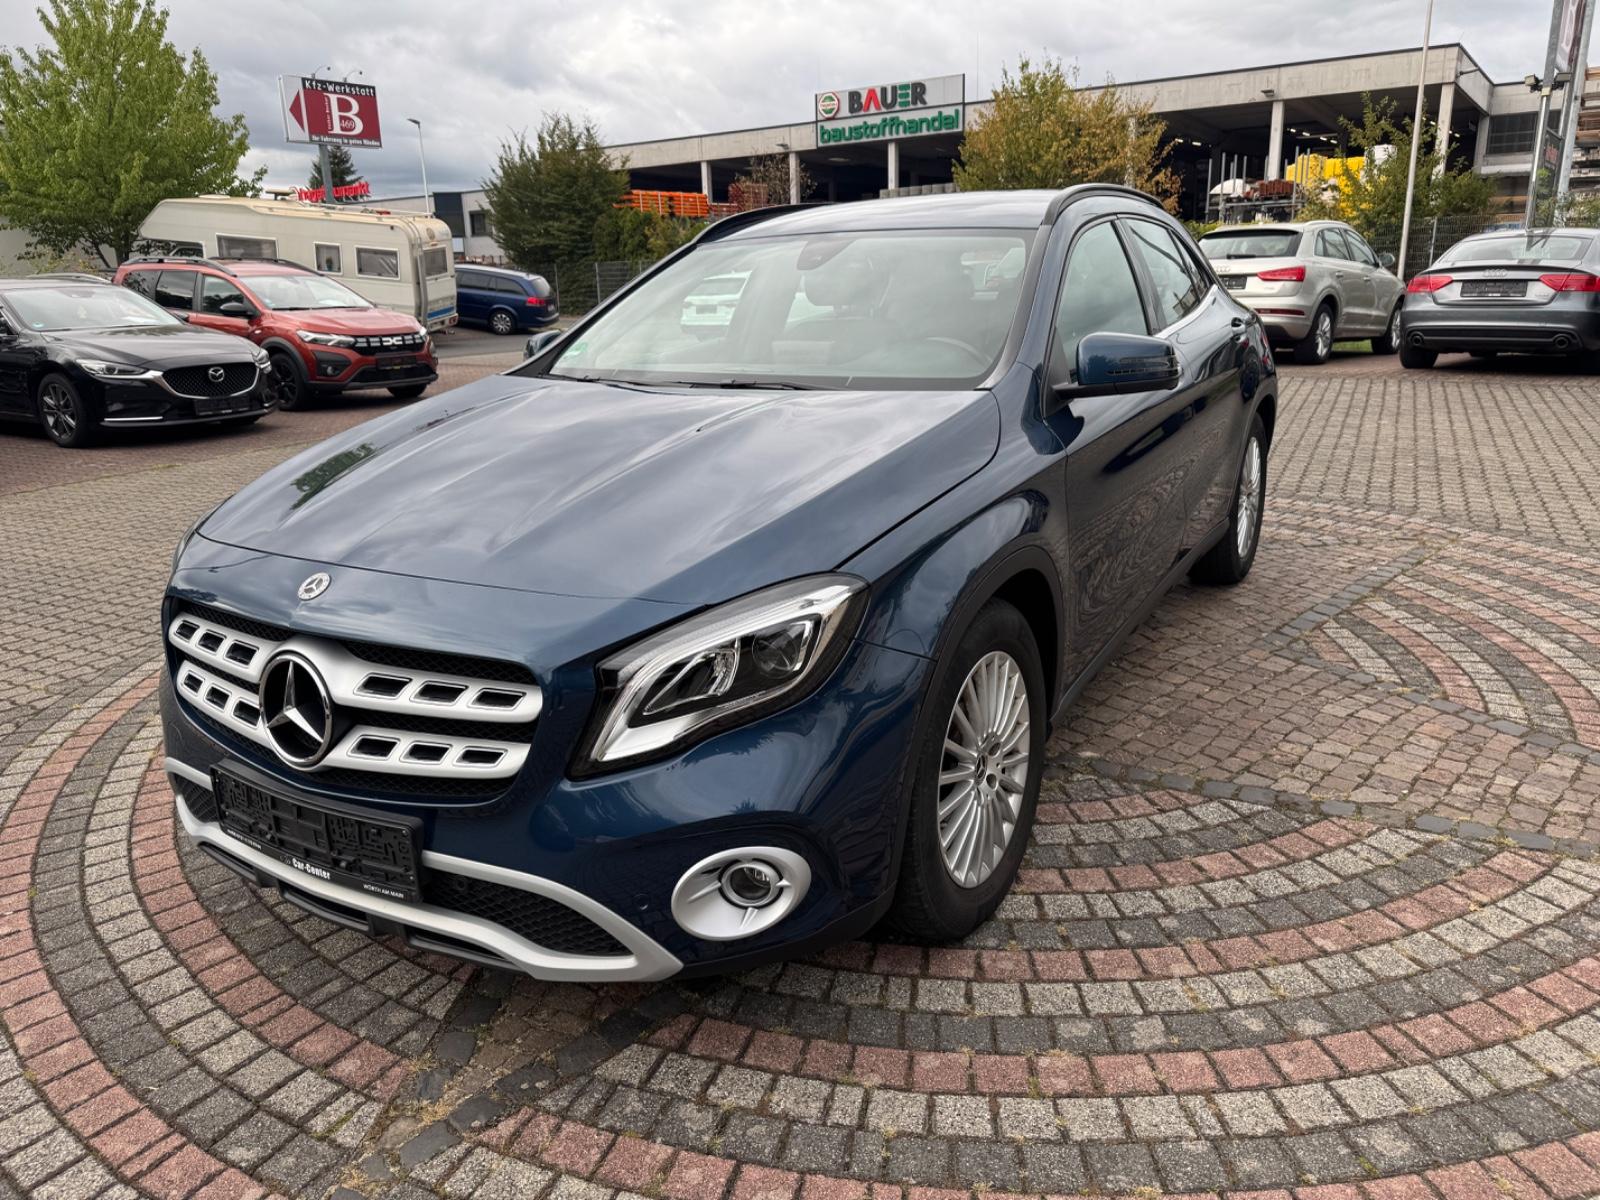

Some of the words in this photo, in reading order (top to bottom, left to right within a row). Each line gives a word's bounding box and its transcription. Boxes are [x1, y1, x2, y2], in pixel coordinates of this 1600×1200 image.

[305, 80, 374, 97] Kfz-Werkstatt
[848, 82, 927, 114] BAUER
[323, 92, 364, 135] B
[820, 109, 960, 144] baustoffhandel
